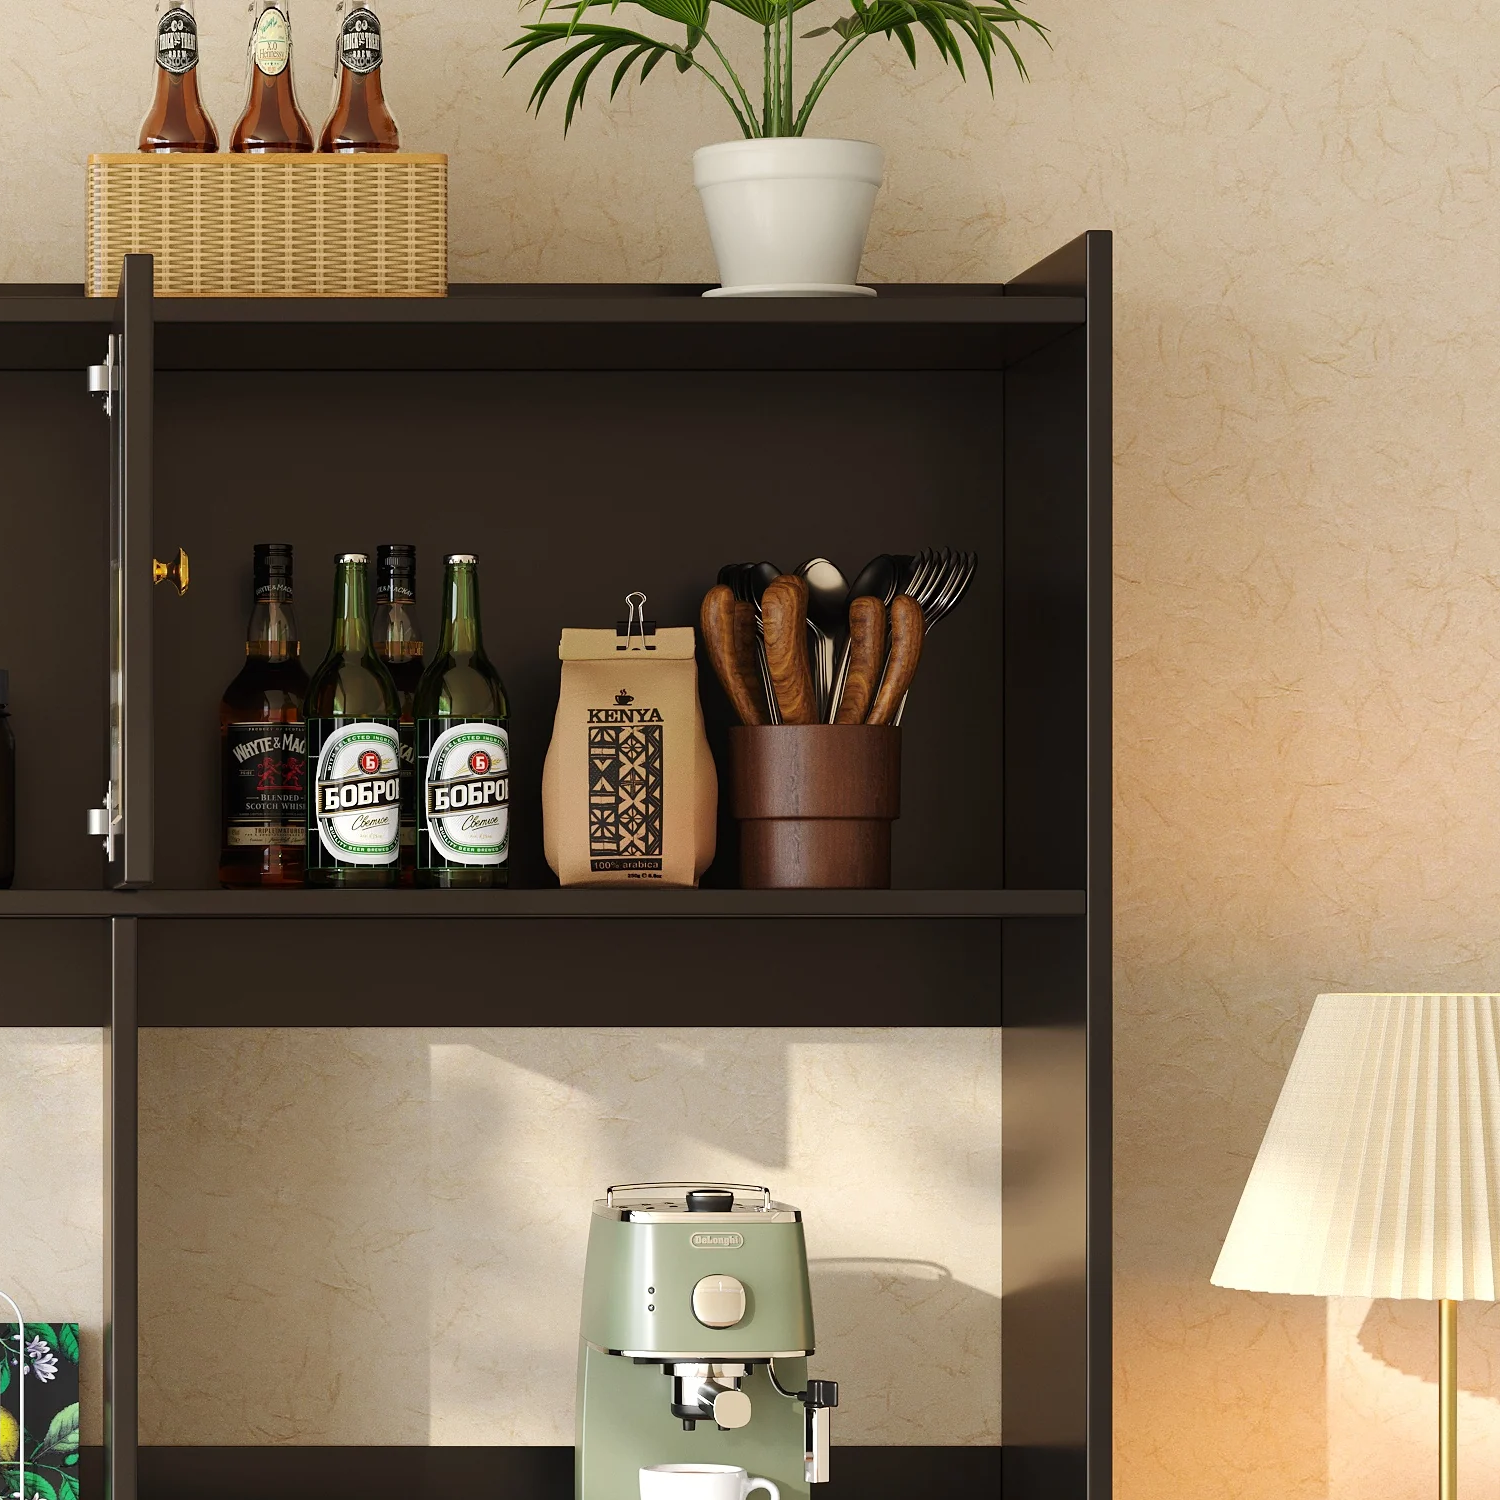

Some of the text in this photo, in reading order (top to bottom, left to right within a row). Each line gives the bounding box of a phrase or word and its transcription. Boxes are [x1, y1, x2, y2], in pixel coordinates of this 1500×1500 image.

[587, 708, 664, 724] KENYA
[232, 734, 306, 763] WHYTE & MAC
[335, 735, 370, 751] SELECTED
[445, 735, 480, 751] SELECTED
[329, 826, 346, 848] QUALITY
[439, 826, 456, 848] QUALITY
